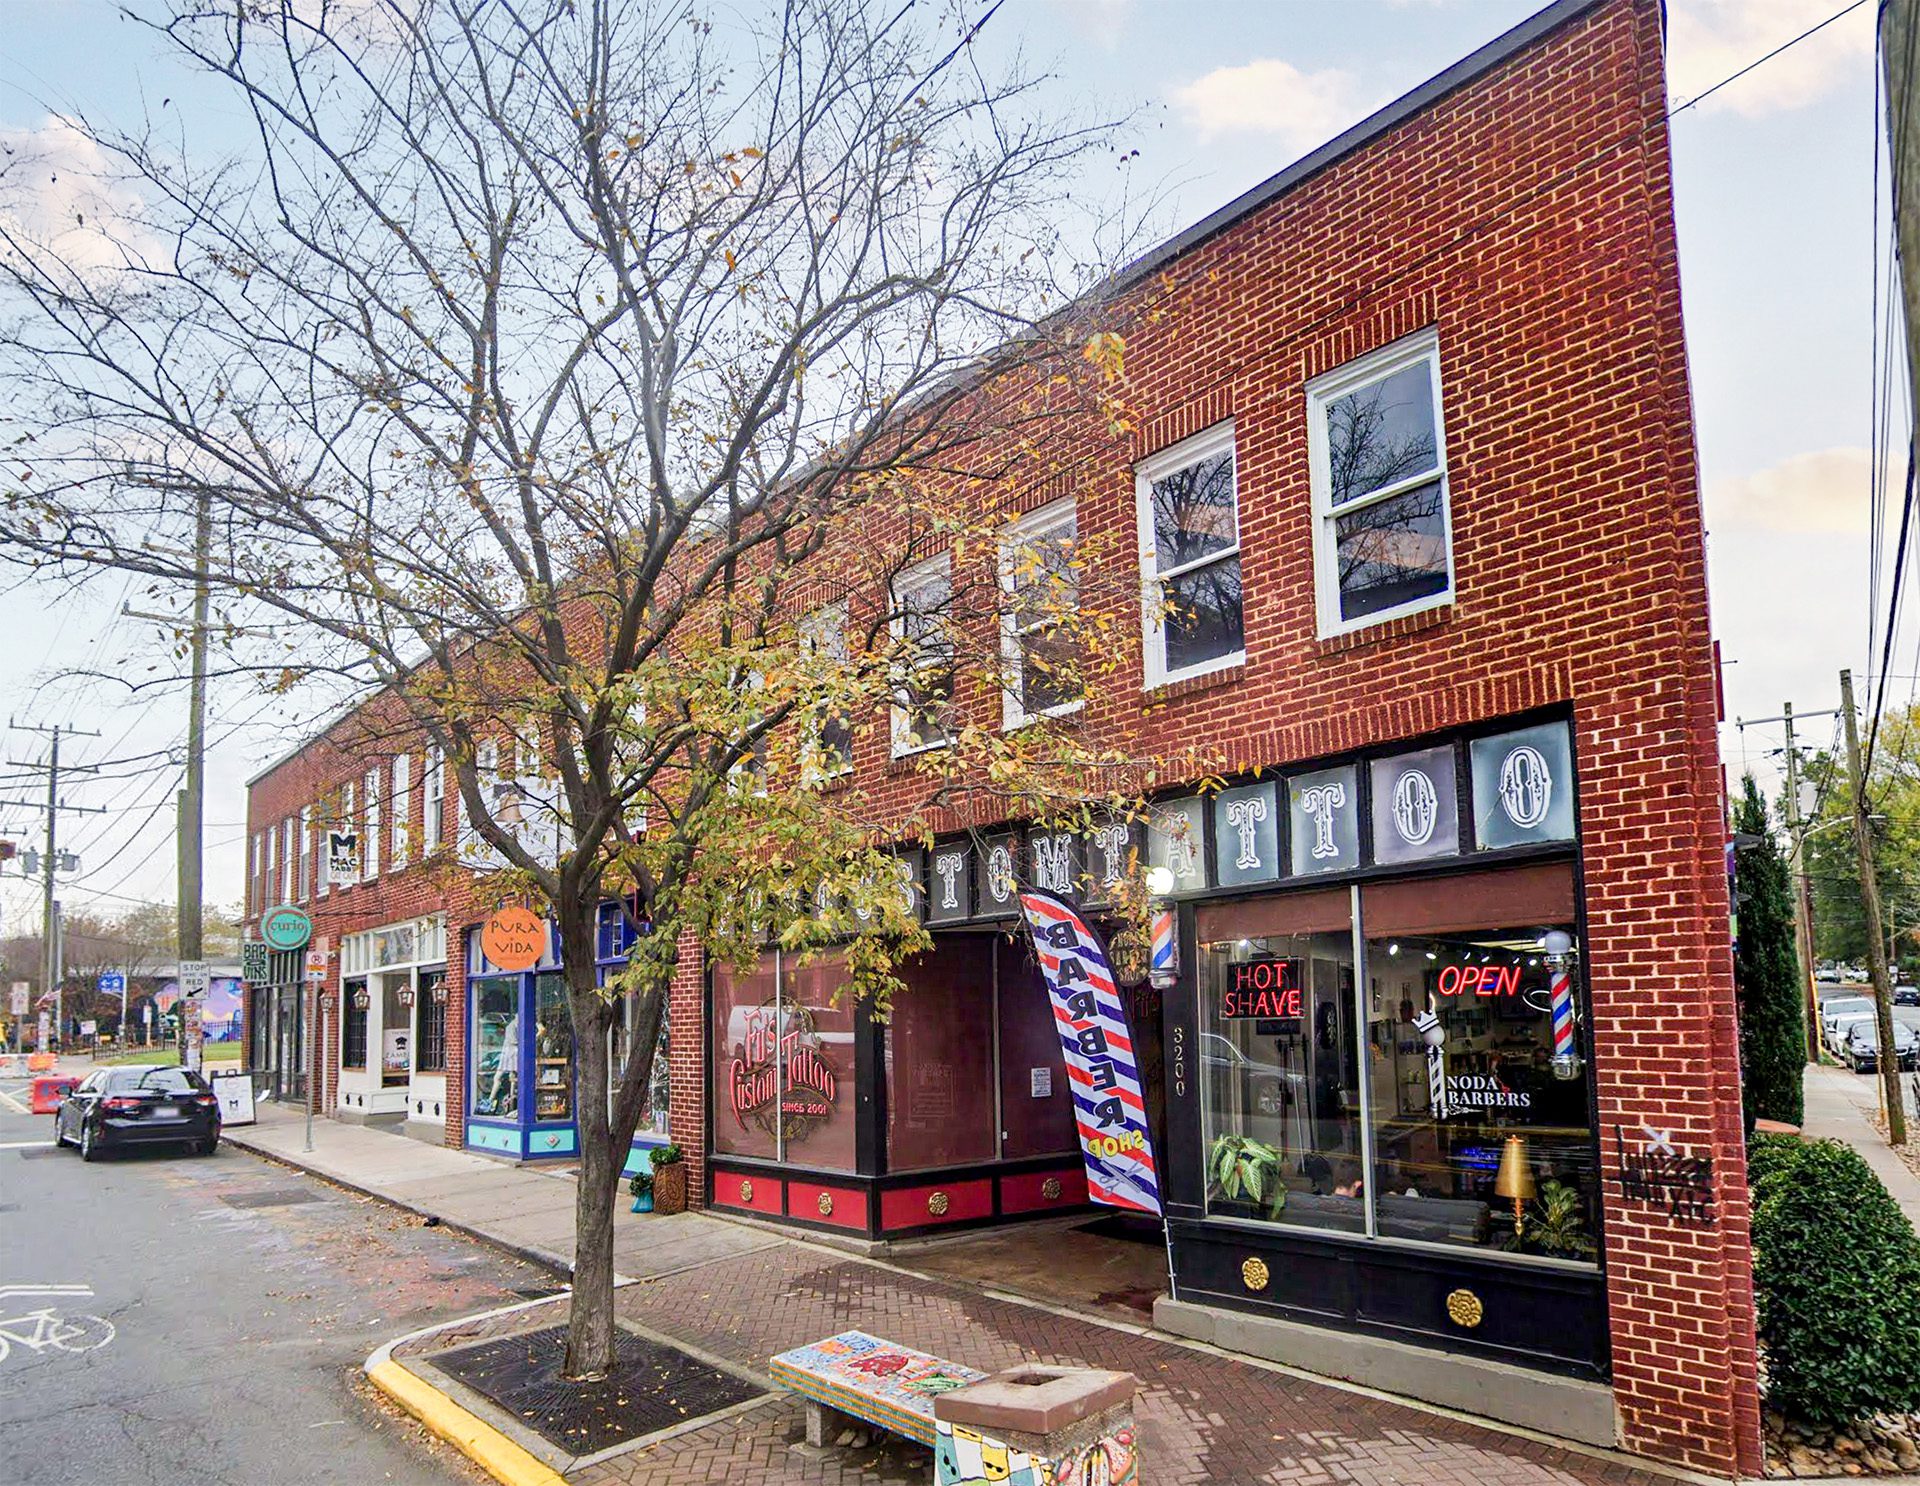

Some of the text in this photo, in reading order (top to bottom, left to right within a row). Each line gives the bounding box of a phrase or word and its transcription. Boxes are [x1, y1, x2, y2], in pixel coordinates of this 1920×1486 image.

[1094, 745, 1552, 889] TATTOO
[331, 857, 358, 866] MAC
[271, 919, 305, 931] curio
[491, 920, 540, 934] PURA
[243, 944, 267, 959] BAR
[495, 942, 534, 954] VIDA
[1236, 963, 1288, 990] HOT
[1438, 966, 1522, 997] OPEN
[1225, 990, 1301, 1016] SHAVE
[1172, 1026, 1186, 1097] 3200
[728, 1059, 777, 1131] Custom
[780, 1030, 835, 1101] Tattoo
[1447, 1075, 1499, 1091] NODA
[1449, 1092, 1531, 1107] BARBERS
[781, 1102, 826, 1115] SINCE 2001
